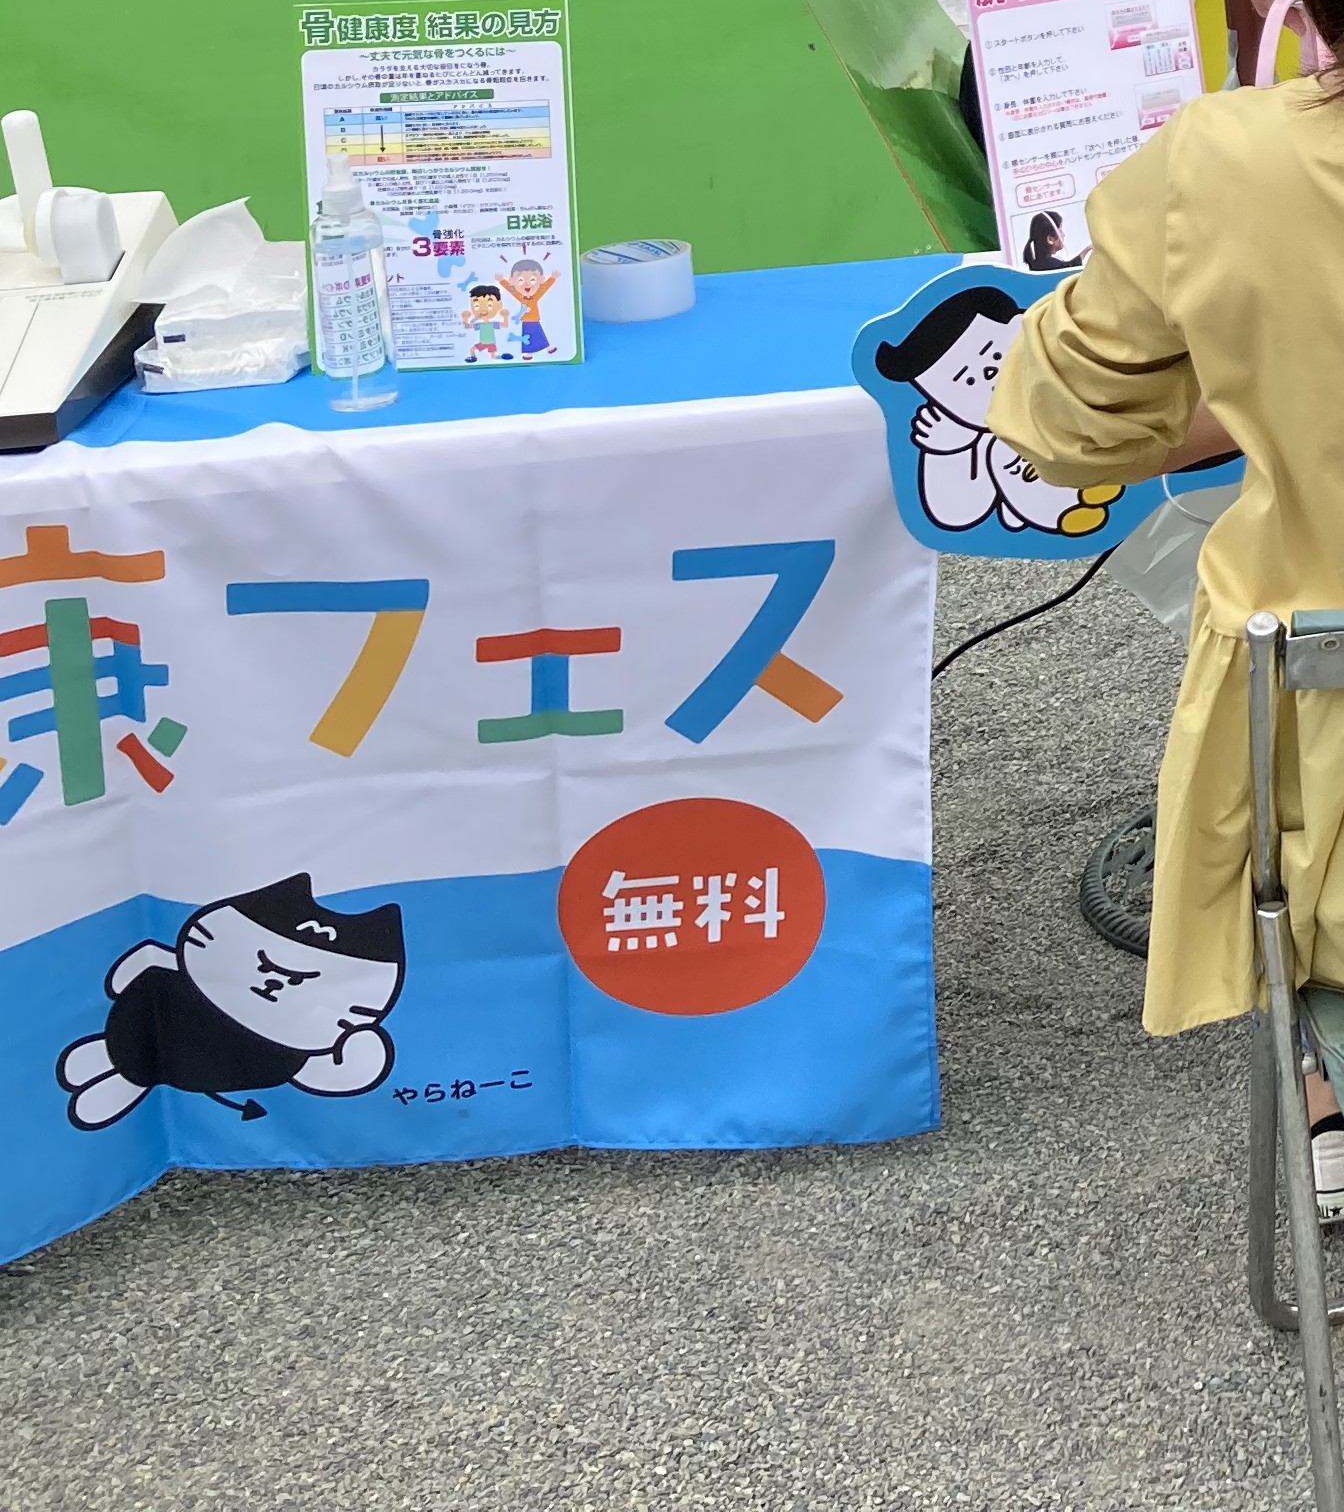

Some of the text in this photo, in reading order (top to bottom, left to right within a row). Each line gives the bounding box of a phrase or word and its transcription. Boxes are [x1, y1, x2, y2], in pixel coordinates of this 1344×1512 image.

[301, 9, 560, 44] 骨健康度 結果の見方
[432, 228, 464, 239] 骨強化
[507, 213, 553, 230] 日光浴
[412, 236, 465, 257] 3要素
[602, 867, 785, 952] 無料
[392, 1070, 533, 1105] やらねーこ
